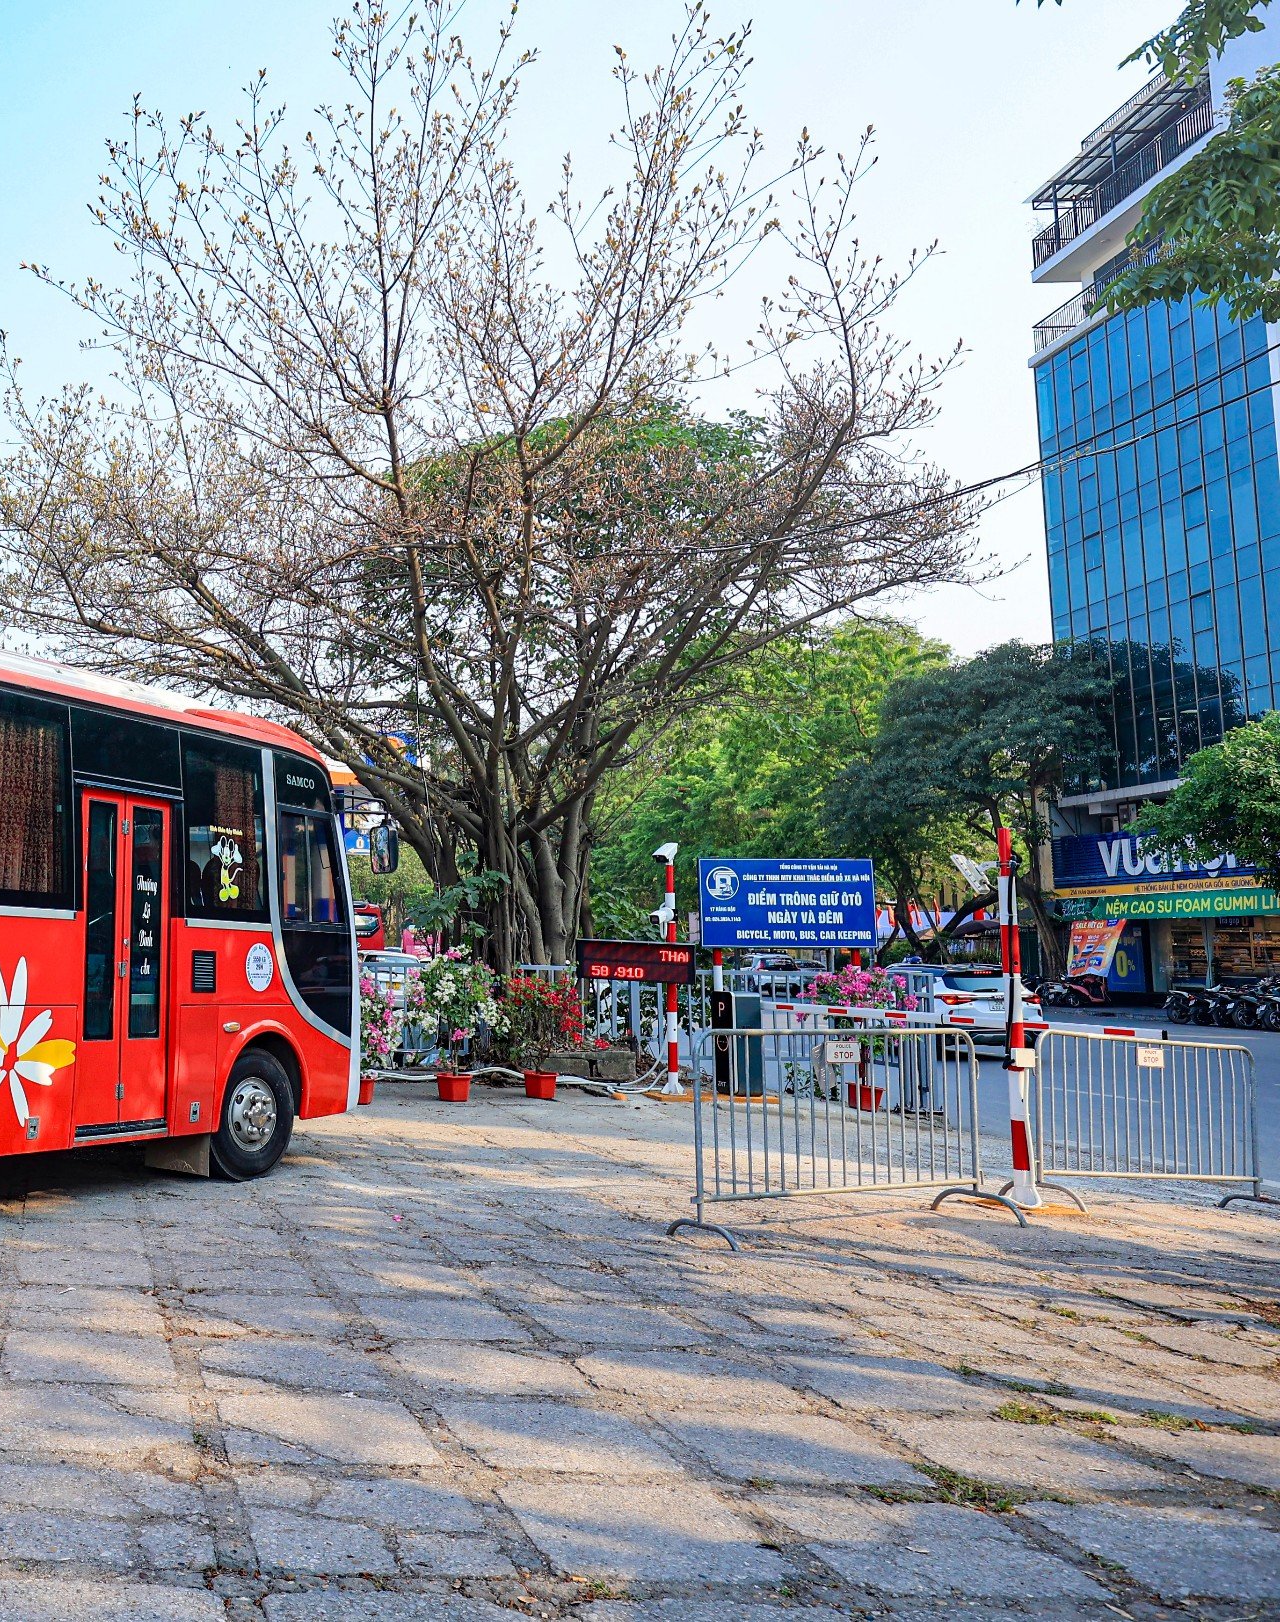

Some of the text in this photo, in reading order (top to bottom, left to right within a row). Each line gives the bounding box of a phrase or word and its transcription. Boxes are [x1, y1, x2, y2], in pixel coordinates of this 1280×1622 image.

[286, 773, 315, 790] SAMCO
[742, 873, 757, 881] CÔNG
[806, 873, 821, 881] THÁC
[821, 872, 835, 881] ĐIỂM
[852, 873, 860, 881] HÀ
[860, 873, 870, 882] NỘI
[1134, 885, 1140, 893] HỆ
[1141, 884, 1157, 892] THỐNG
[1177, 882, 1188, 891] NỆM
[1205, 881, 1212, 889] GA
[1214, 880, 1224, 888] GỐI
[1231, 878, 1254, 887] GIƯỜNG
[747, 888, 863, 906] ĐIỂM TRÔNG GIỮ ÔTÔ
[1105, 898, 1129, 918] NỆM
[1131, 900, 1155, 914] CAO
[1157, 899, 1172, 914] SU
[1175, 897, 1211, 913] FOAM
[1213, 895, 1258, 911] GUMMI
[767, 909, 844, 924] NGÀY VÀ ĐÊM
[736, 930, 872, 941] BICYCLE, MOTO, BUS, CAR KEEPING
[659, 950, 689, 963] THAI
[718, 1001, 725, 1018] P
[833, 1051, 854, 1060] STOP
